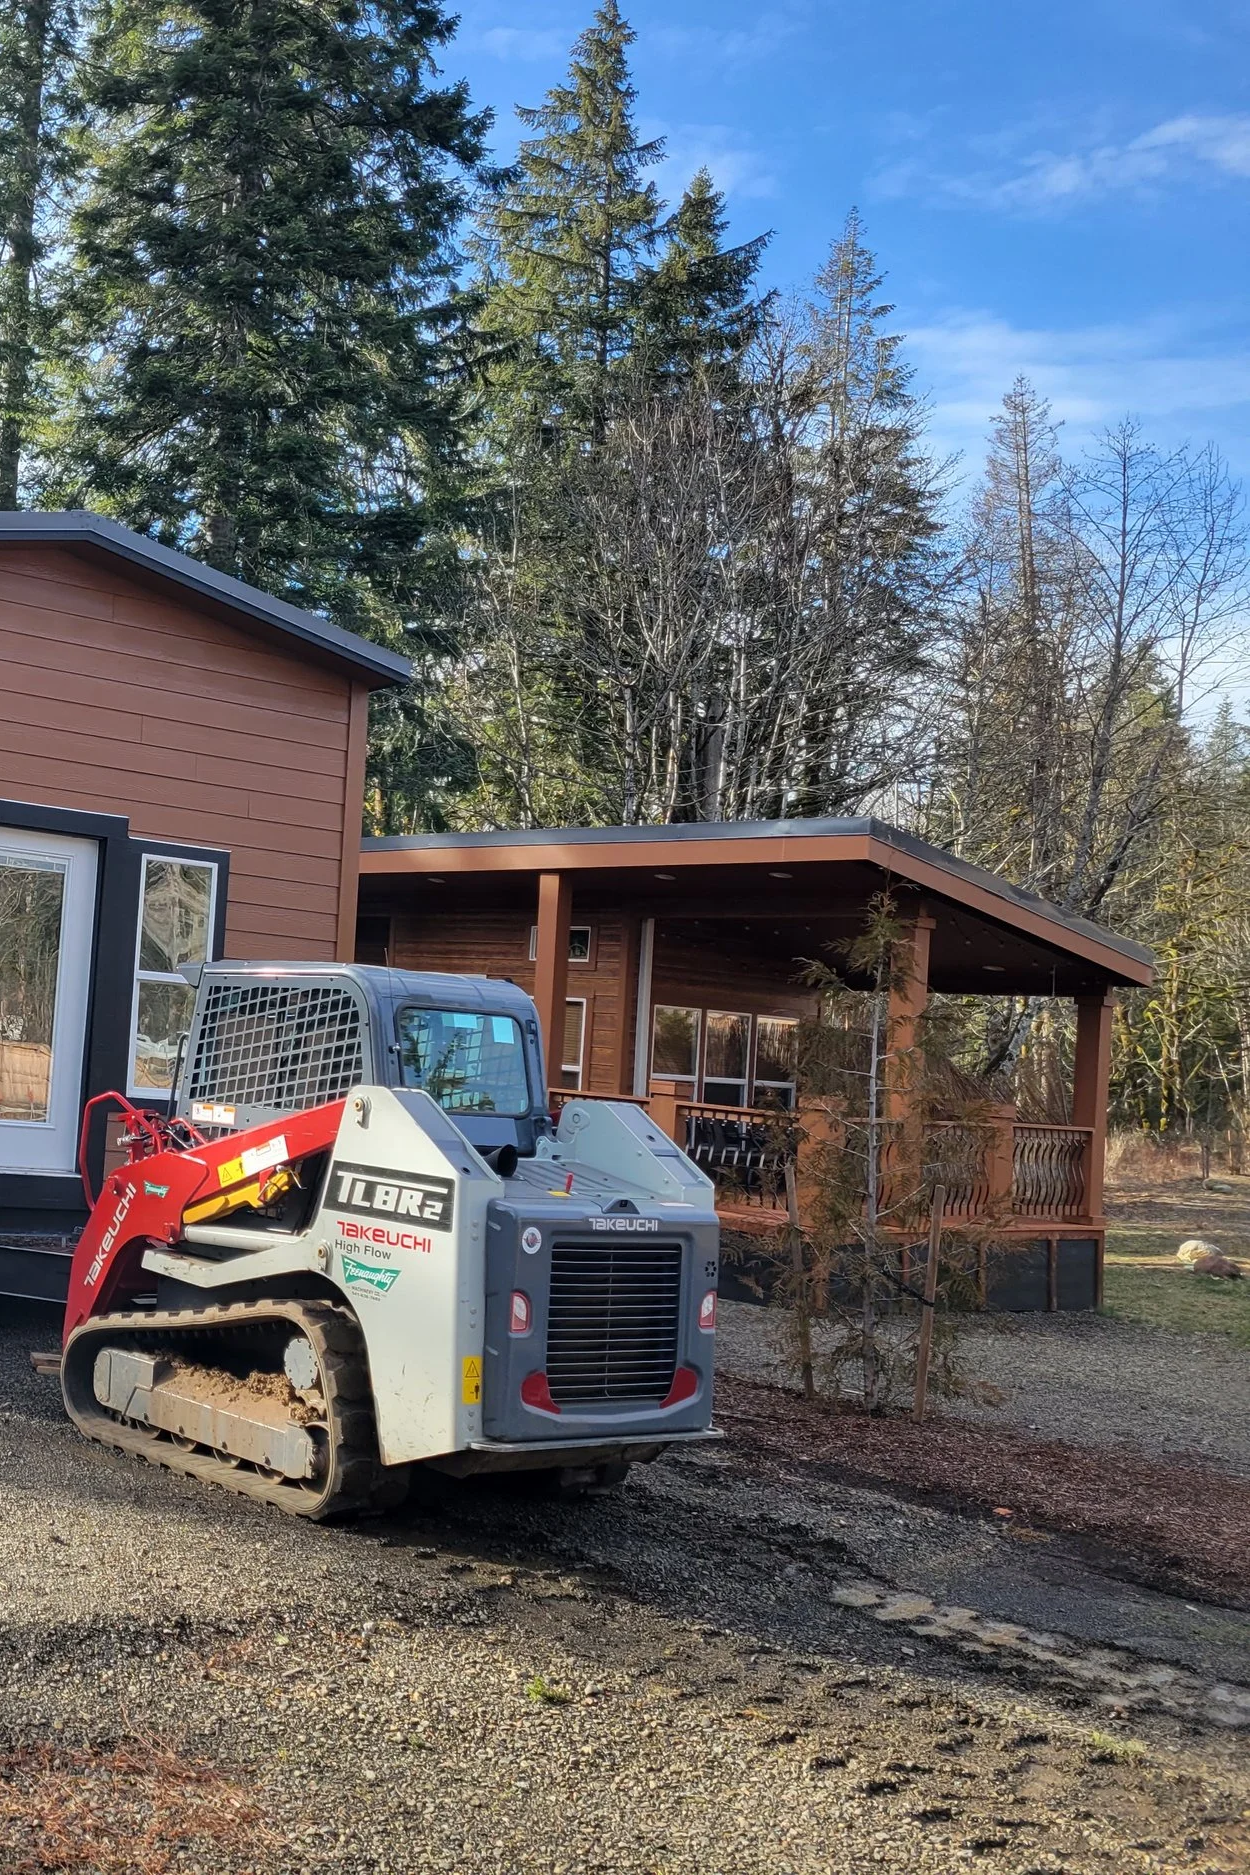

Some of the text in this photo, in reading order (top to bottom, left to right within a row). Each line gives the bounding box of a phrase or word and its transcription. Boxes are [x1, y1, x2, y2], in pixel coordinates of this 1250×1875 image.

[337, 1171, 448, 1221] TL8R2
[334, 1239, 392, 1260] High Flow
[343, 1259, 397, 1290] Feenaughty
